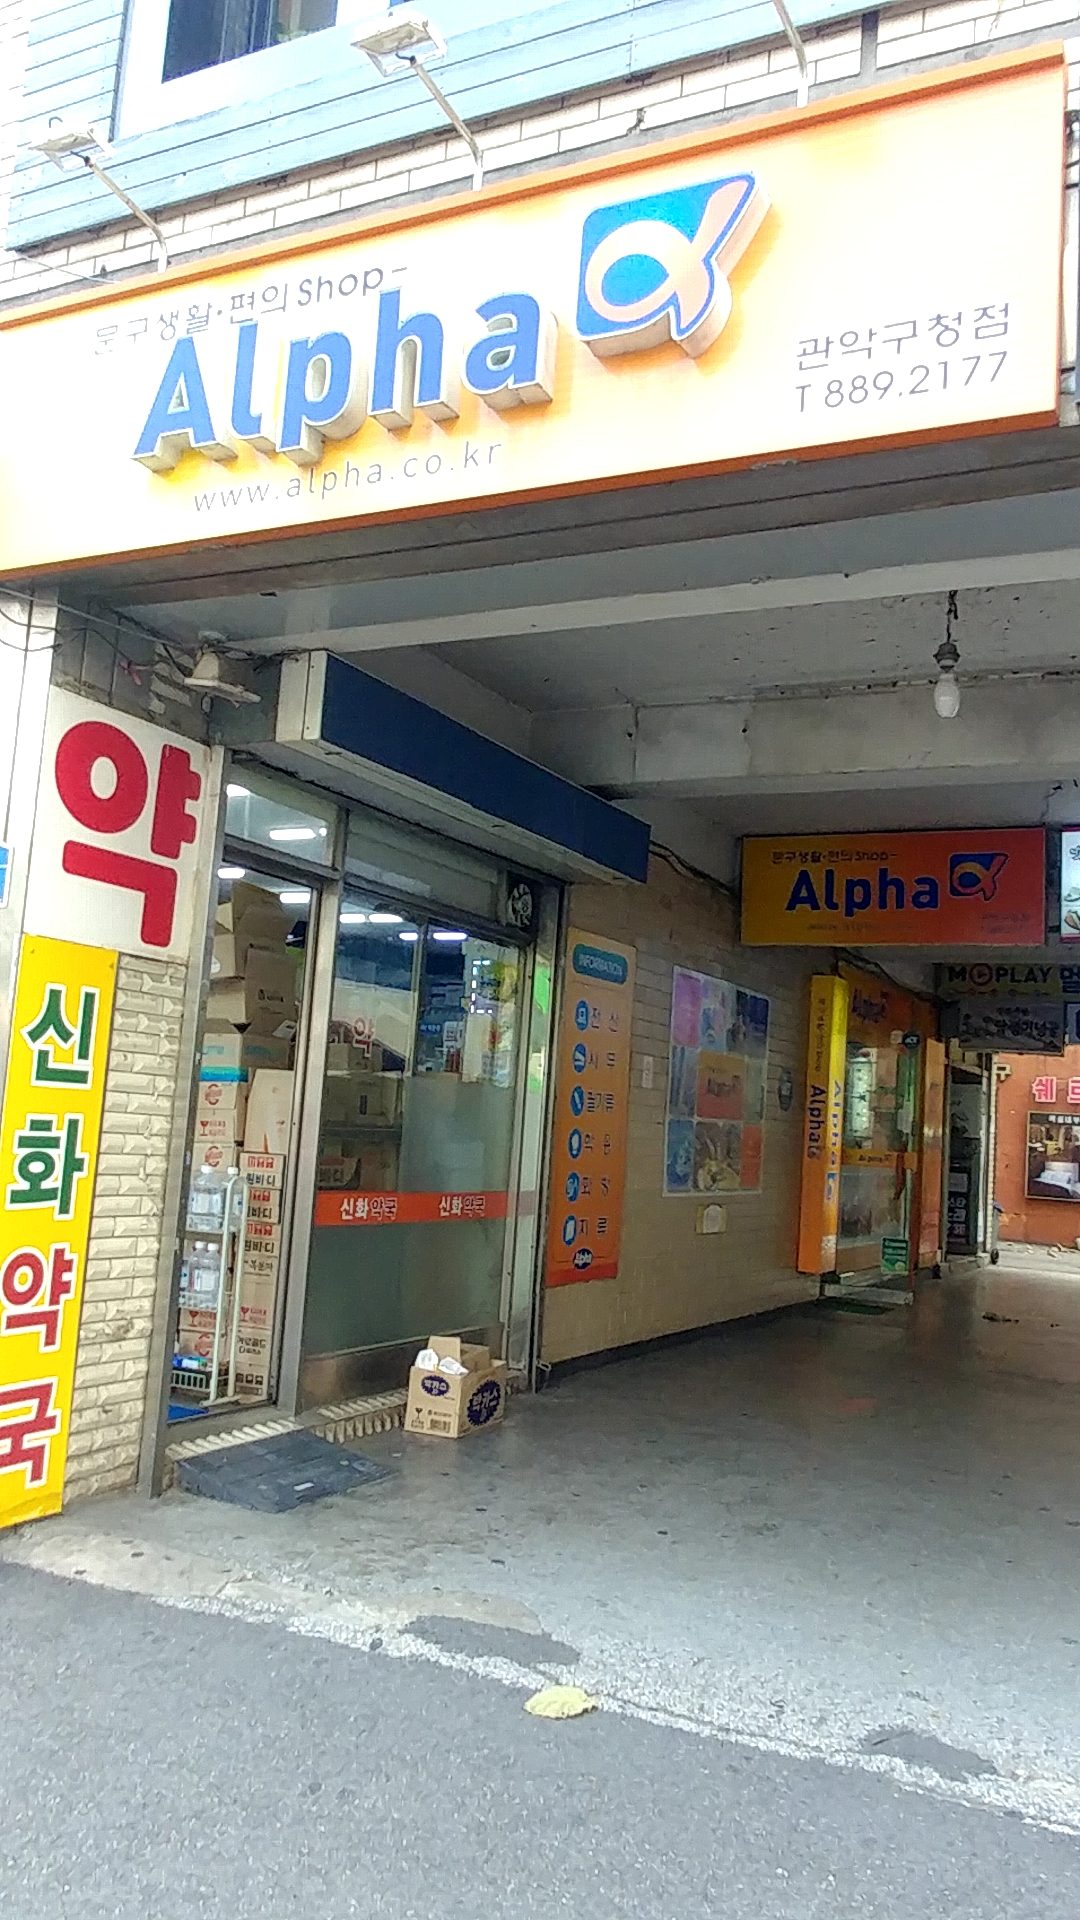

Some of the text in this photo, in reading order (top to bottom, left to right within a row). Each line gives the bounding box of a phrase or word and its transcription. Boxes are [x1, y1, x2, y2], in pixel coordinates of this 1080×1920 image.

[796, 302, 1011, 372] 관악구청점
[132, 286, 550, 468] Alpha
[796, 350, 1009, 412] T 889.2177
[194, 440, 502, 512] www.alpha.co.kr
[55, 720, 202, 948] 약
[785, 867, 940, 918] Alpha
[340, 1196, 398, 1220] 신화약국
[439, 1195, 486, 1218] 신화약국
